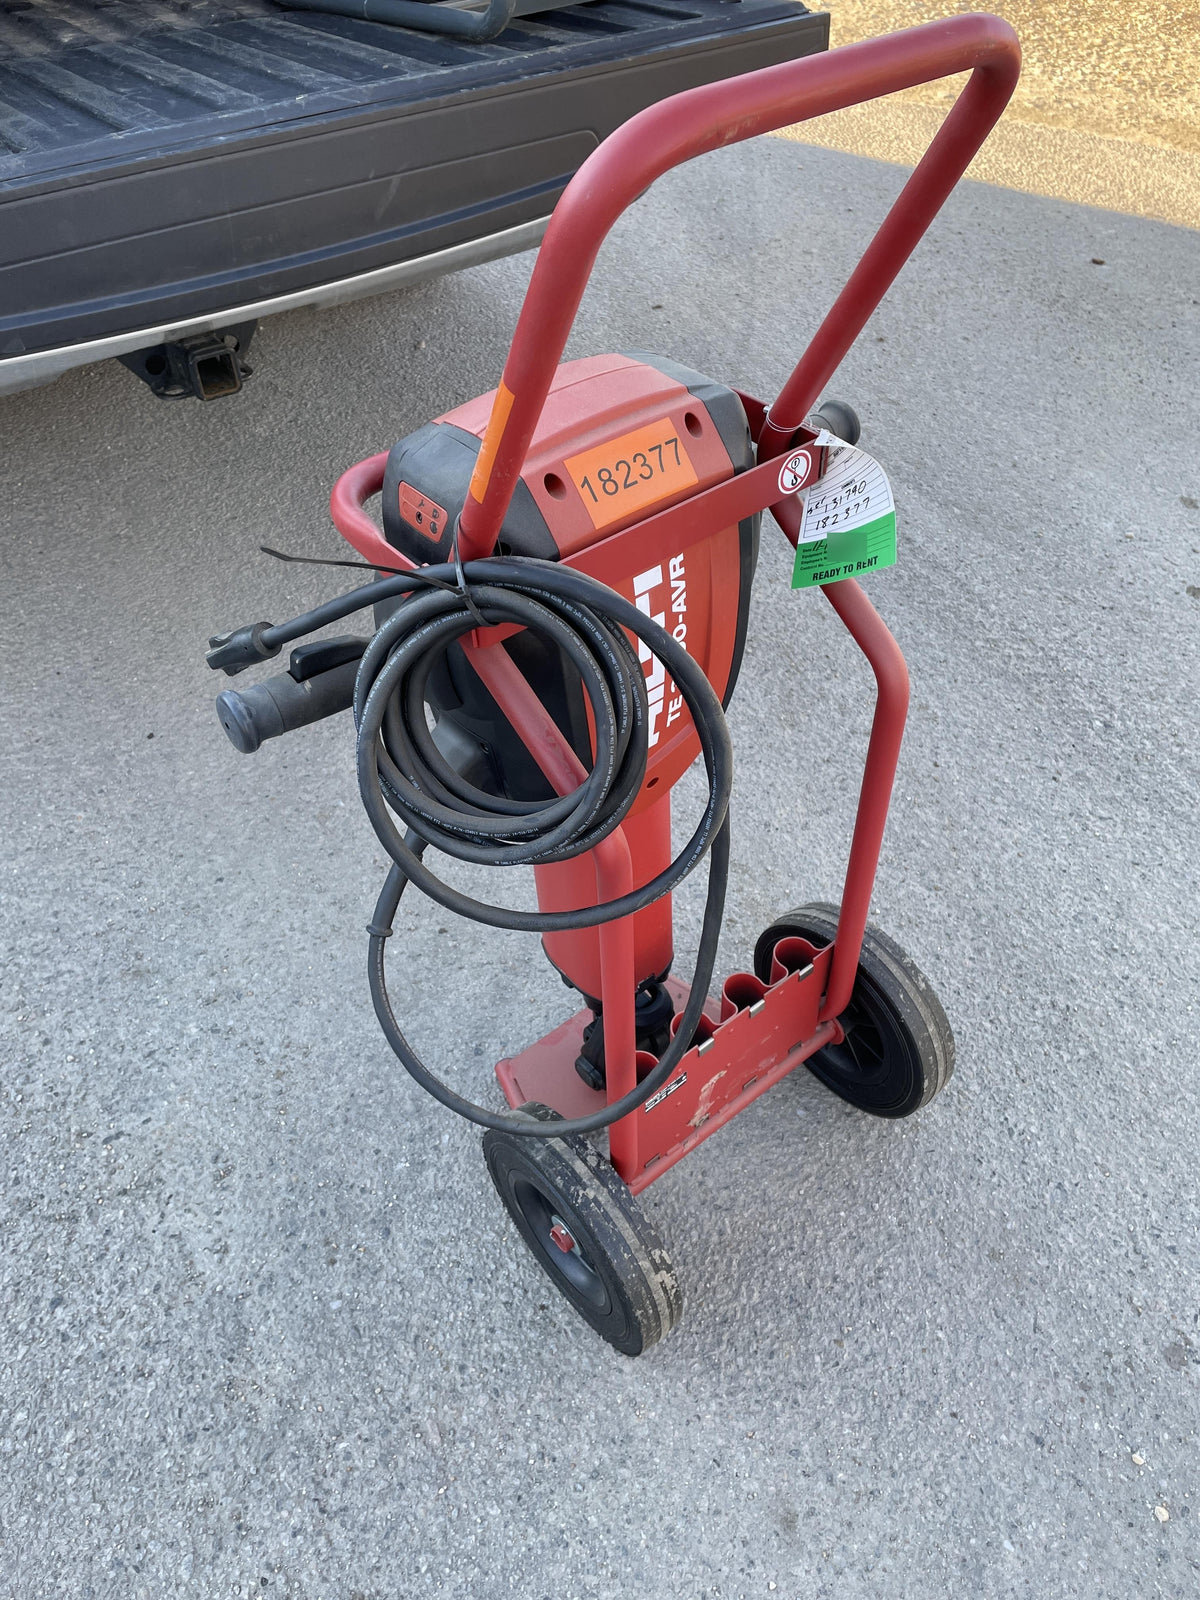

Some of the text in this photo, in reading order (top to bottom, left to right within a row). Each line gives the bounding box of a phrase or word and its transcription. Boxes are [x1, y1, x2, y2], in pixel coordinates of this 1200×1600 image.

[581, 438, 681, 502] 182377
[816, 497, 870, 530] 182377
[812, 556, 879, 581] READY TO RENT
[666, 694, 683, 728] TE
